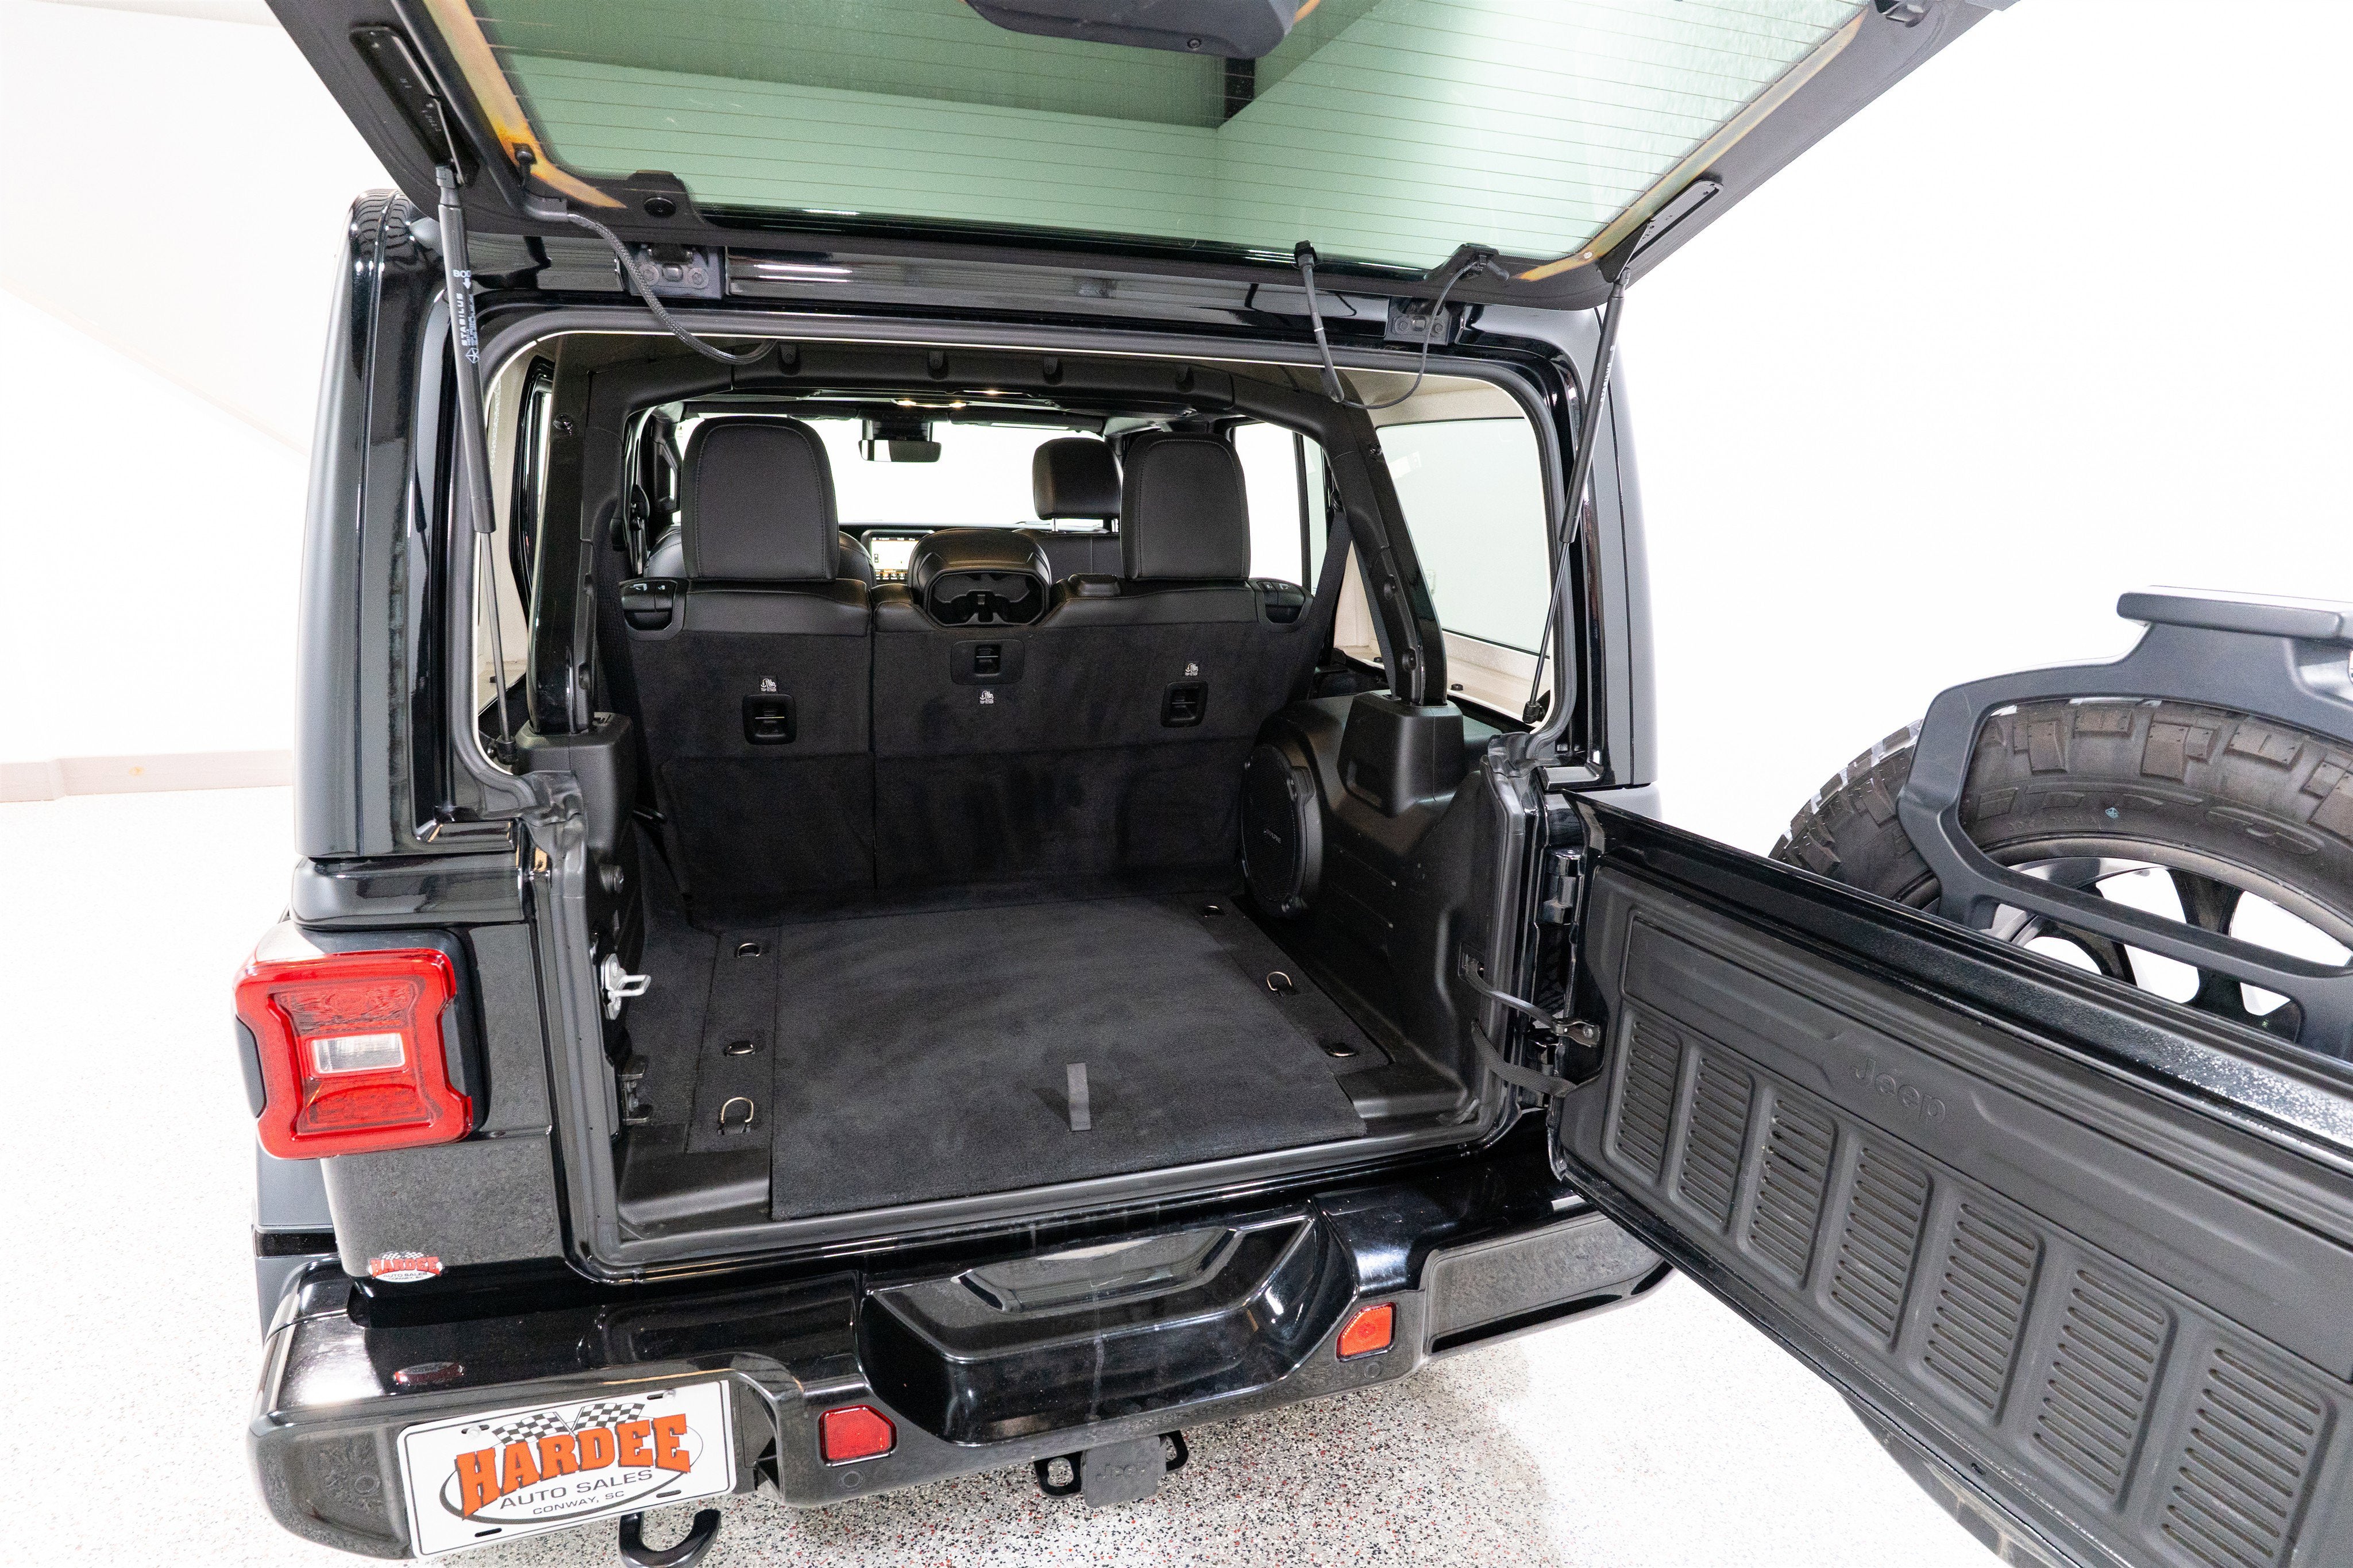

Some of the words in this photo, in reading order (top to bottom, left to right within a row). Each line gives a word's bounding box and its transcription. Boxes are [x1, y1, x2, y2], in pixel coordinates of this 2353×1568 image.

[456, 292, 468, 346] STABILUS
[1851, 1057, 1946, 1124] Jeep
[370, 1256, 441, 1278] HARDEE
[454, 1413, 691, 1521] HARDEE
[499, 1486, 567, 1509] AUTO
[576, 1469, 653, 1493] SALES
[532, 1497, 600, 1515] CONWAY,
[605, 1490, 625, 1500] SC
